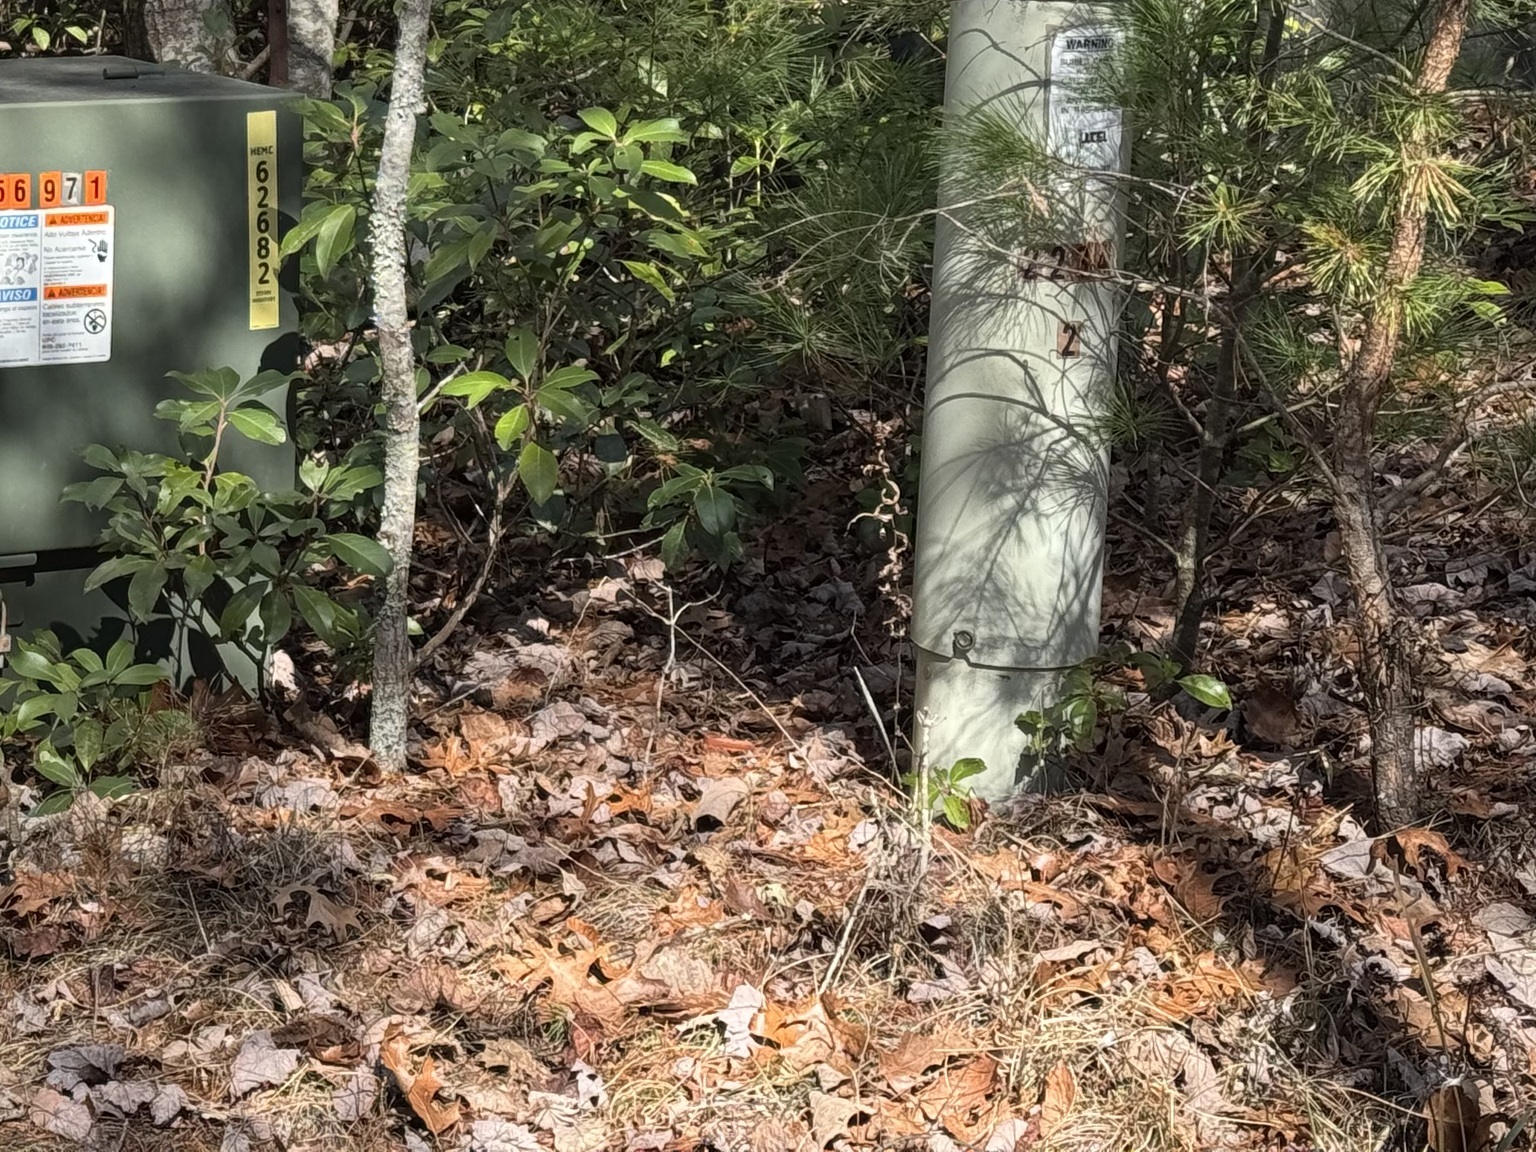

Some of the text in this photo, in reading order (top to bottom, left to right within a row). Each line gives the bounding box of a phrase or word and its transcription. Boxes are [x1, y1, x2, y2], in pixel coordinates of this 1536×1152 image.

[1066, 38, 1114, 50] WARNING
[250, 145, 274, 156] HEMC
[1061, 323, 1077, 356] 2
